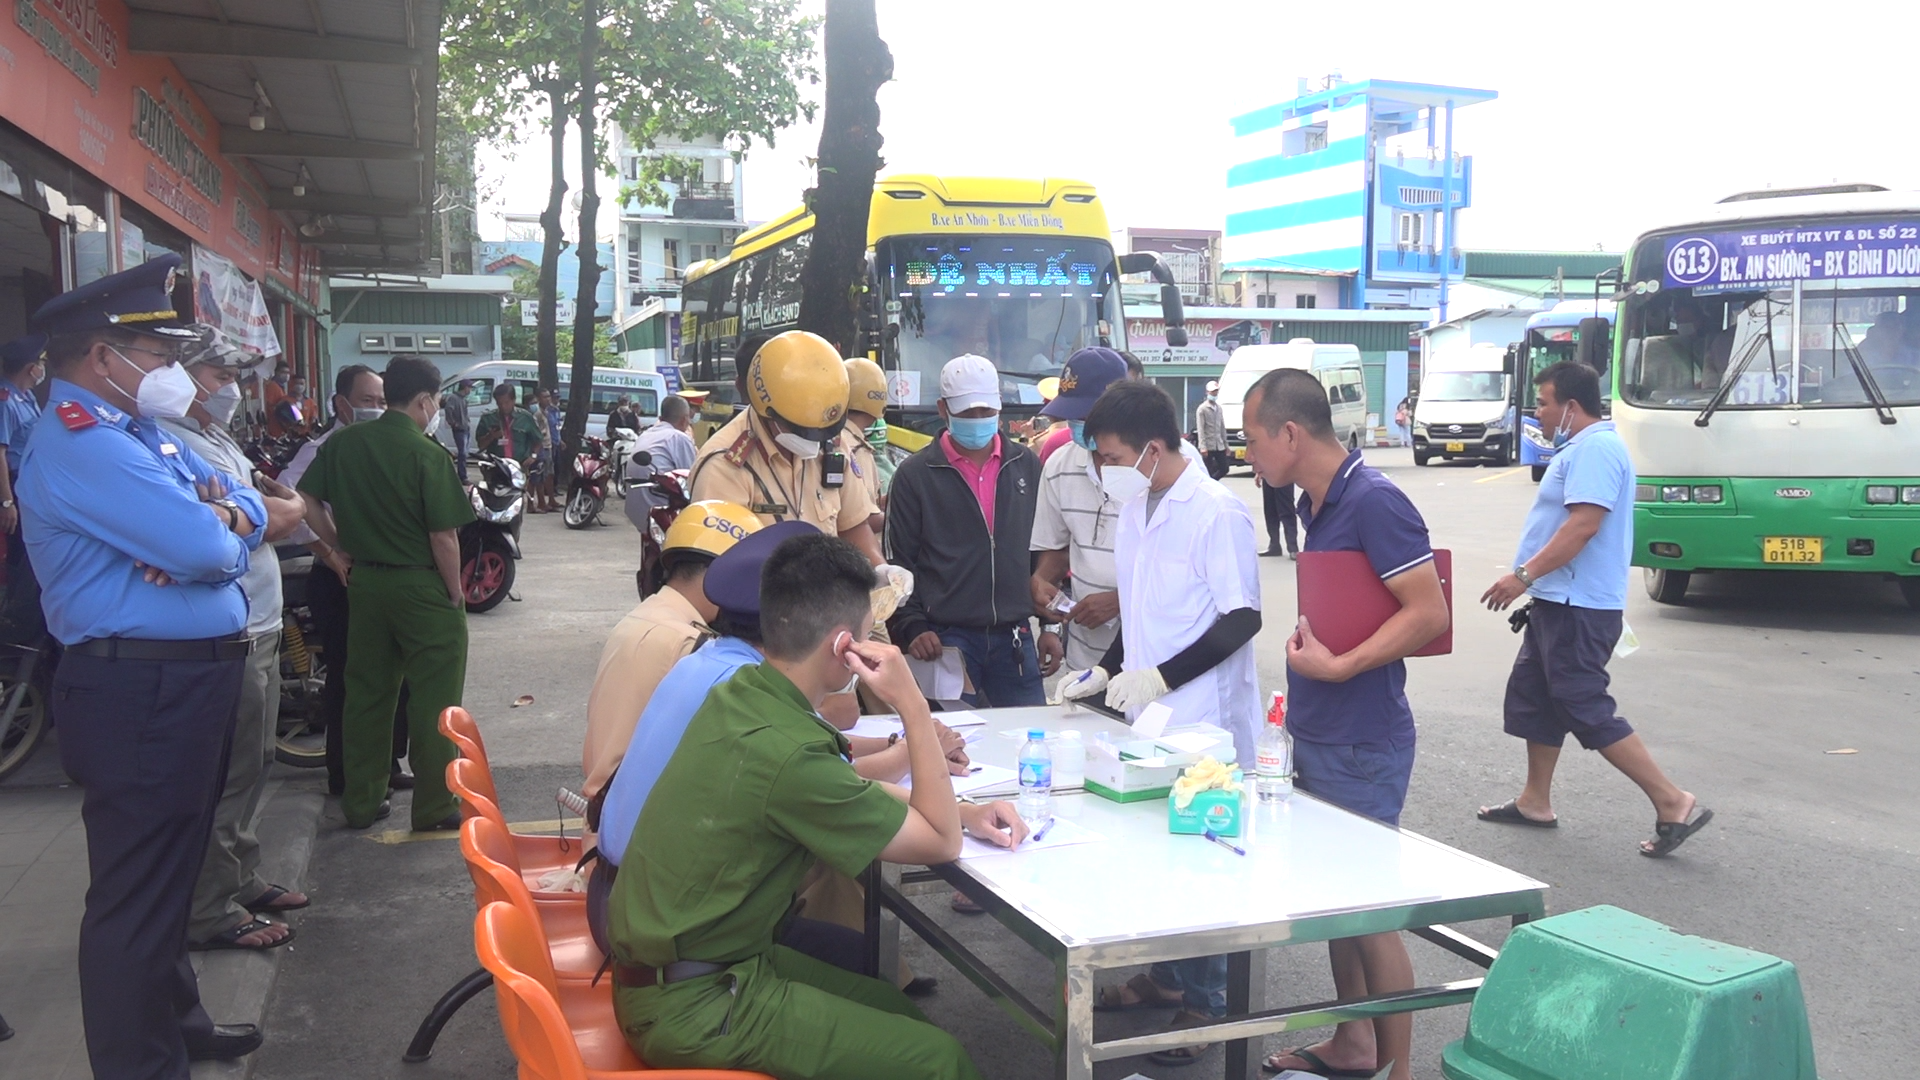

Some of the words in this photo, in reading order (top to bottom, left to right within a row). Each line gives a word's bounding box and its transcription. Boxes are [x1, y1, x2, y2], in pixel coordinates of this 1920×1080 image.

[1741, 235, 1757, 246] XE
[1760, 230, 1794, 245] BUÝT
[1796, 231, 1821, 243] HTX
[1825, 230, 1841, 241] VT
[1844, 229, 1854, 241] &
[1858, 229, 1875, 240] DL
[1878, 224, 1897, 239] SỐ
[1899, 228, 1917, 239] 22
[1673, 245, 1711, 276] 613
[1720, 257, 1742, 282] BX.
[1745, 254, 1764, 279] AN
[1824, 250, 1844, 276] BX
[1848, 243, 1883, 275] BÌNH
[1129, 322, 1168, 338] QUAN
[1185, 320, 1213, 337] ŨNG
[592, 374, 616, 385] HÁCH
[752, 354, 771, 403] CSGT
[1733, 373, 1788, 405] 613
[1775, 489, 1811, 497] SAMCO
[1780, 538, 1805, 550] 51B
[1770, 551, 1815, 562] 011.32
